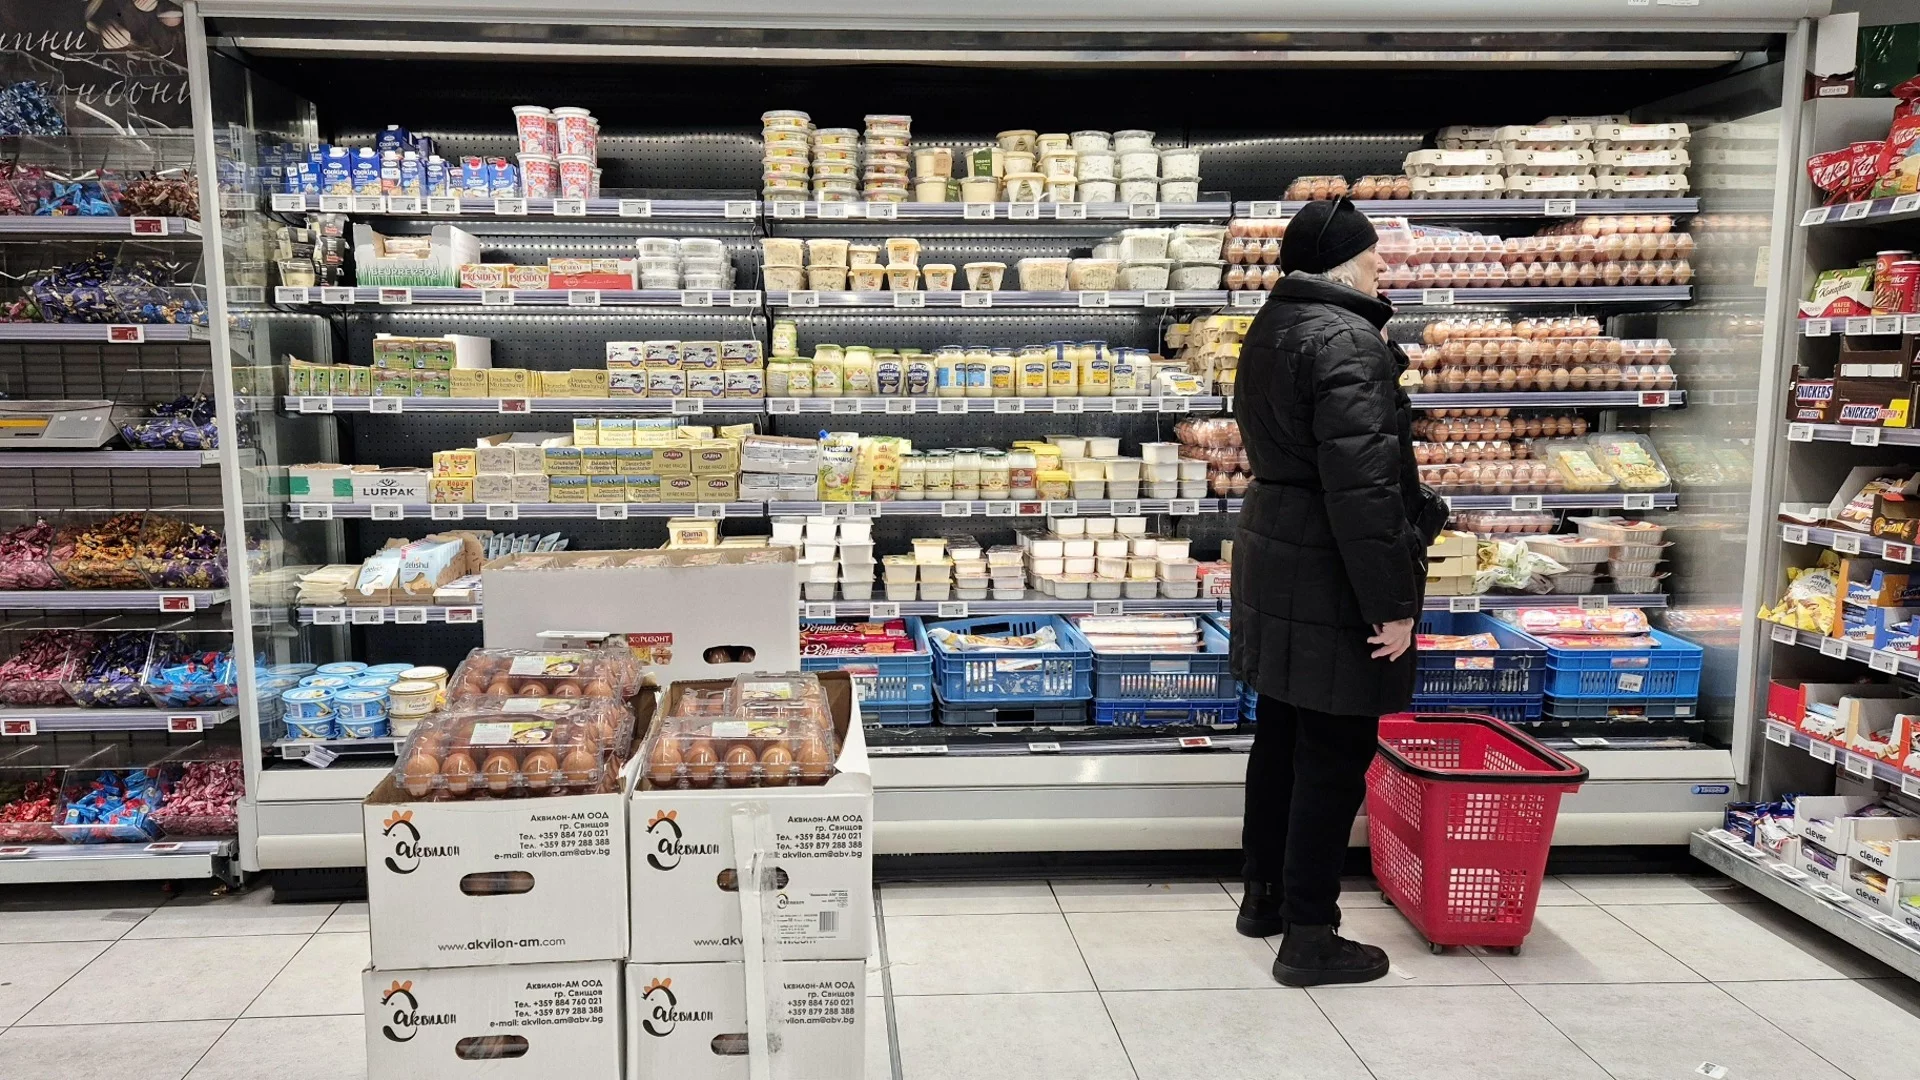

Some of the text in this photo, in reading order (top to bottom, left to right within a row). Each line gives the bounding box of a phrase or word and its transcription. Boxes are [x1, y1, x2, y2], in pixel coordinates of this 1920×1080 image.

[1797, 386, 1833, 398] SNICKERS
[1842, 406, 1878, 418] SNICKERS
[363, 488, 414, 496] LURPAK
[681, 530, 703, 538] Rama
[1848, 591, 1871, 601] Knoppers
[1845, 628, 1868, 638] Knoppers
[1888, 640, 1912, 649] Knoppers
[530, 812, 609, 822] Аквилон-АМ ООД
[788, 815, 840, 823] Аквилон-АМ
[574, 822, 609, 830] Свищов
[829, 823, 862, 832] Свищов
[578, 830, 593, 838] 760
[1805, 826, 1826, 843] clever
[561, 840, 576, 848] 879
[578, 839, 594, 847] 288
[815, 841, 830, 849] 879
[832, 841, 847, 849] 288
[494, 848, 610, 860] e-mail: akvilon.am@abv.bg
[782, 850, 862, 859] akvilon.am@abv.bg
[1860, 849, 1883, 867] clever
[1807, 863, 1829, 880] clever
[1856, 887, 1880, 905] clever
[438, 937, 566, 951] www.akvilon-am.com
[526, 982, 580, 990] Аквилон-АМ
[835, 981, 855, 989] ООД
[568, 989, 603, 997] Свищов
[821, 990, 854, 998] Свищов
[572, 1007, 587, 1015] 288
[589, 1006, 603, 1014] 388
[490, 1015, 603, 1027] e-mail: akvilon.am@abv.bg
[785, 1016, 854, 1025] vilon.am@abv.bg
